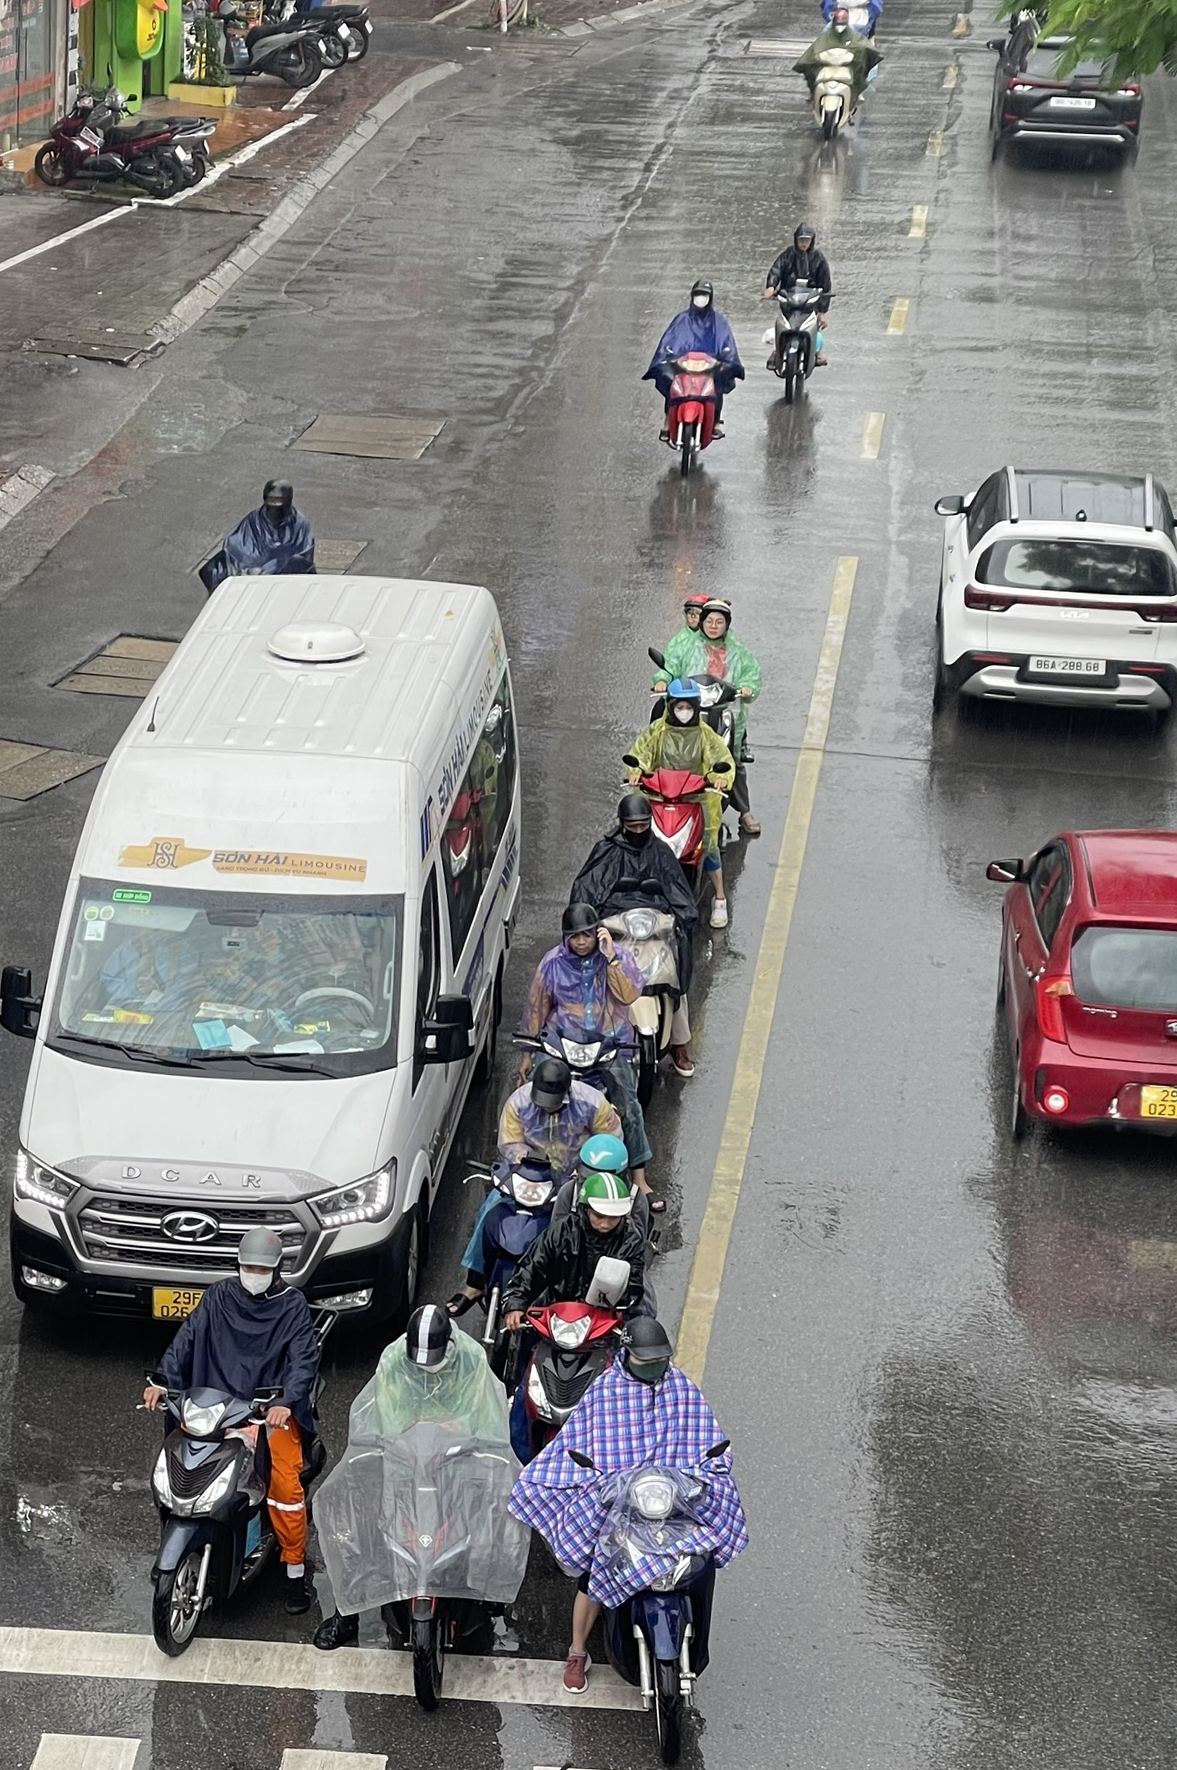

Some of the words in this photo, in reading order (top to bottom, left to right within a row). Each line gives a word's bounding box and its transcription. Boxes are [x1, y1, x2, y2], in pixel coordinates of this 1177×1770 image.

[212, 851, 252, 864] SƠN
[254, 852, 289, 866] HẢI
[291, 859, 366, 873] LIMOUSINE
[1148, 1103, 1176, 1117] 023
[122, 1166, 261, 1188] DCAR
